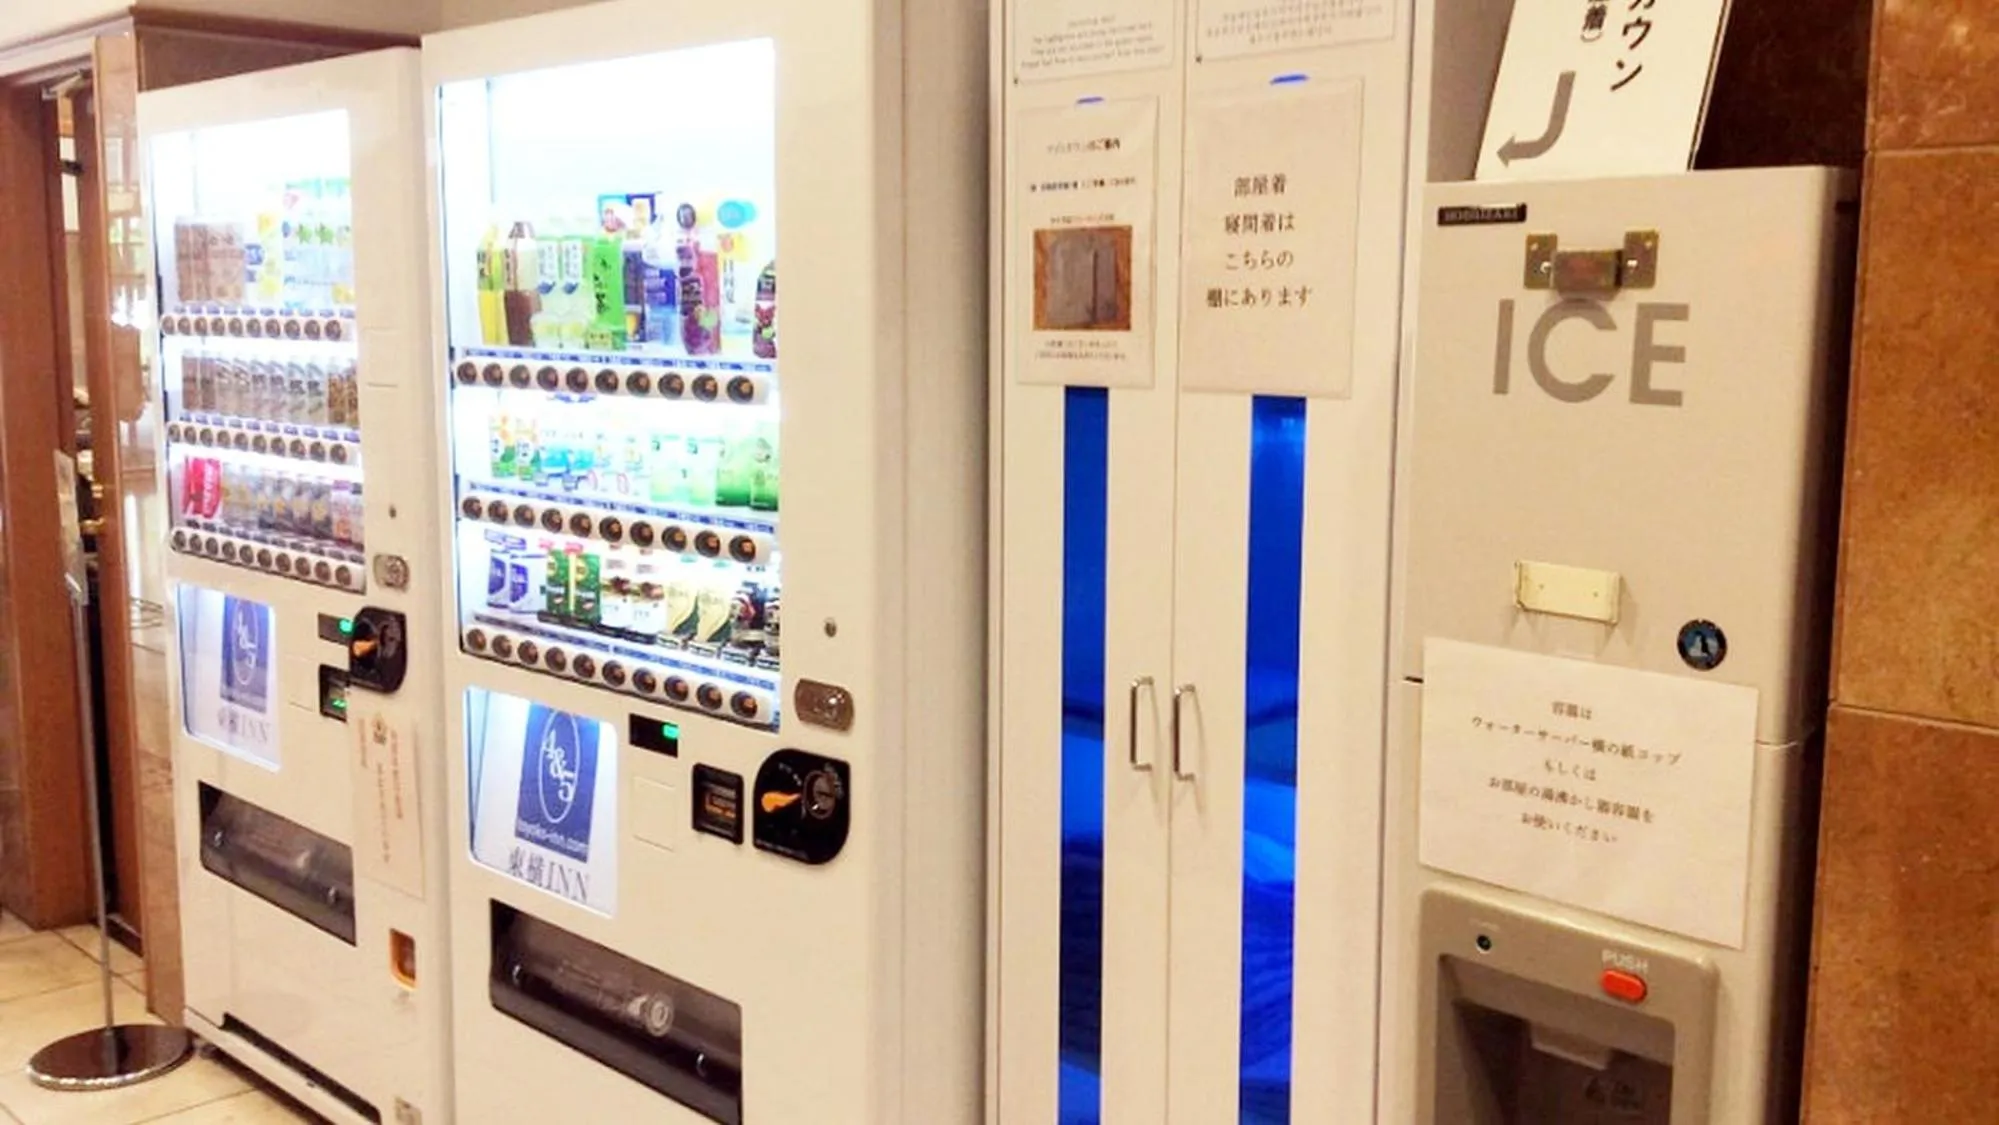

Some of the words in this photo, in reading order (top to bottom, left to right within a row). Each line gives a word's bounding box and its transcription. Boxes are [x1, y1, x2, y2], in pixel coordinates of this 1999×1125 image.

[1234, 173, 1287, 198] 部屋着
[1224, 211, 1295, 236] 寝間着は
[1225, 249, 1295, 271] こちらの
[1206, 285, 1313, 309] 棚にあります
[1493, 298, 1690, 407] ICE
[1543, 758, 1598, 782] もしくは
[1601, 949, 1649, 976] PUSH
